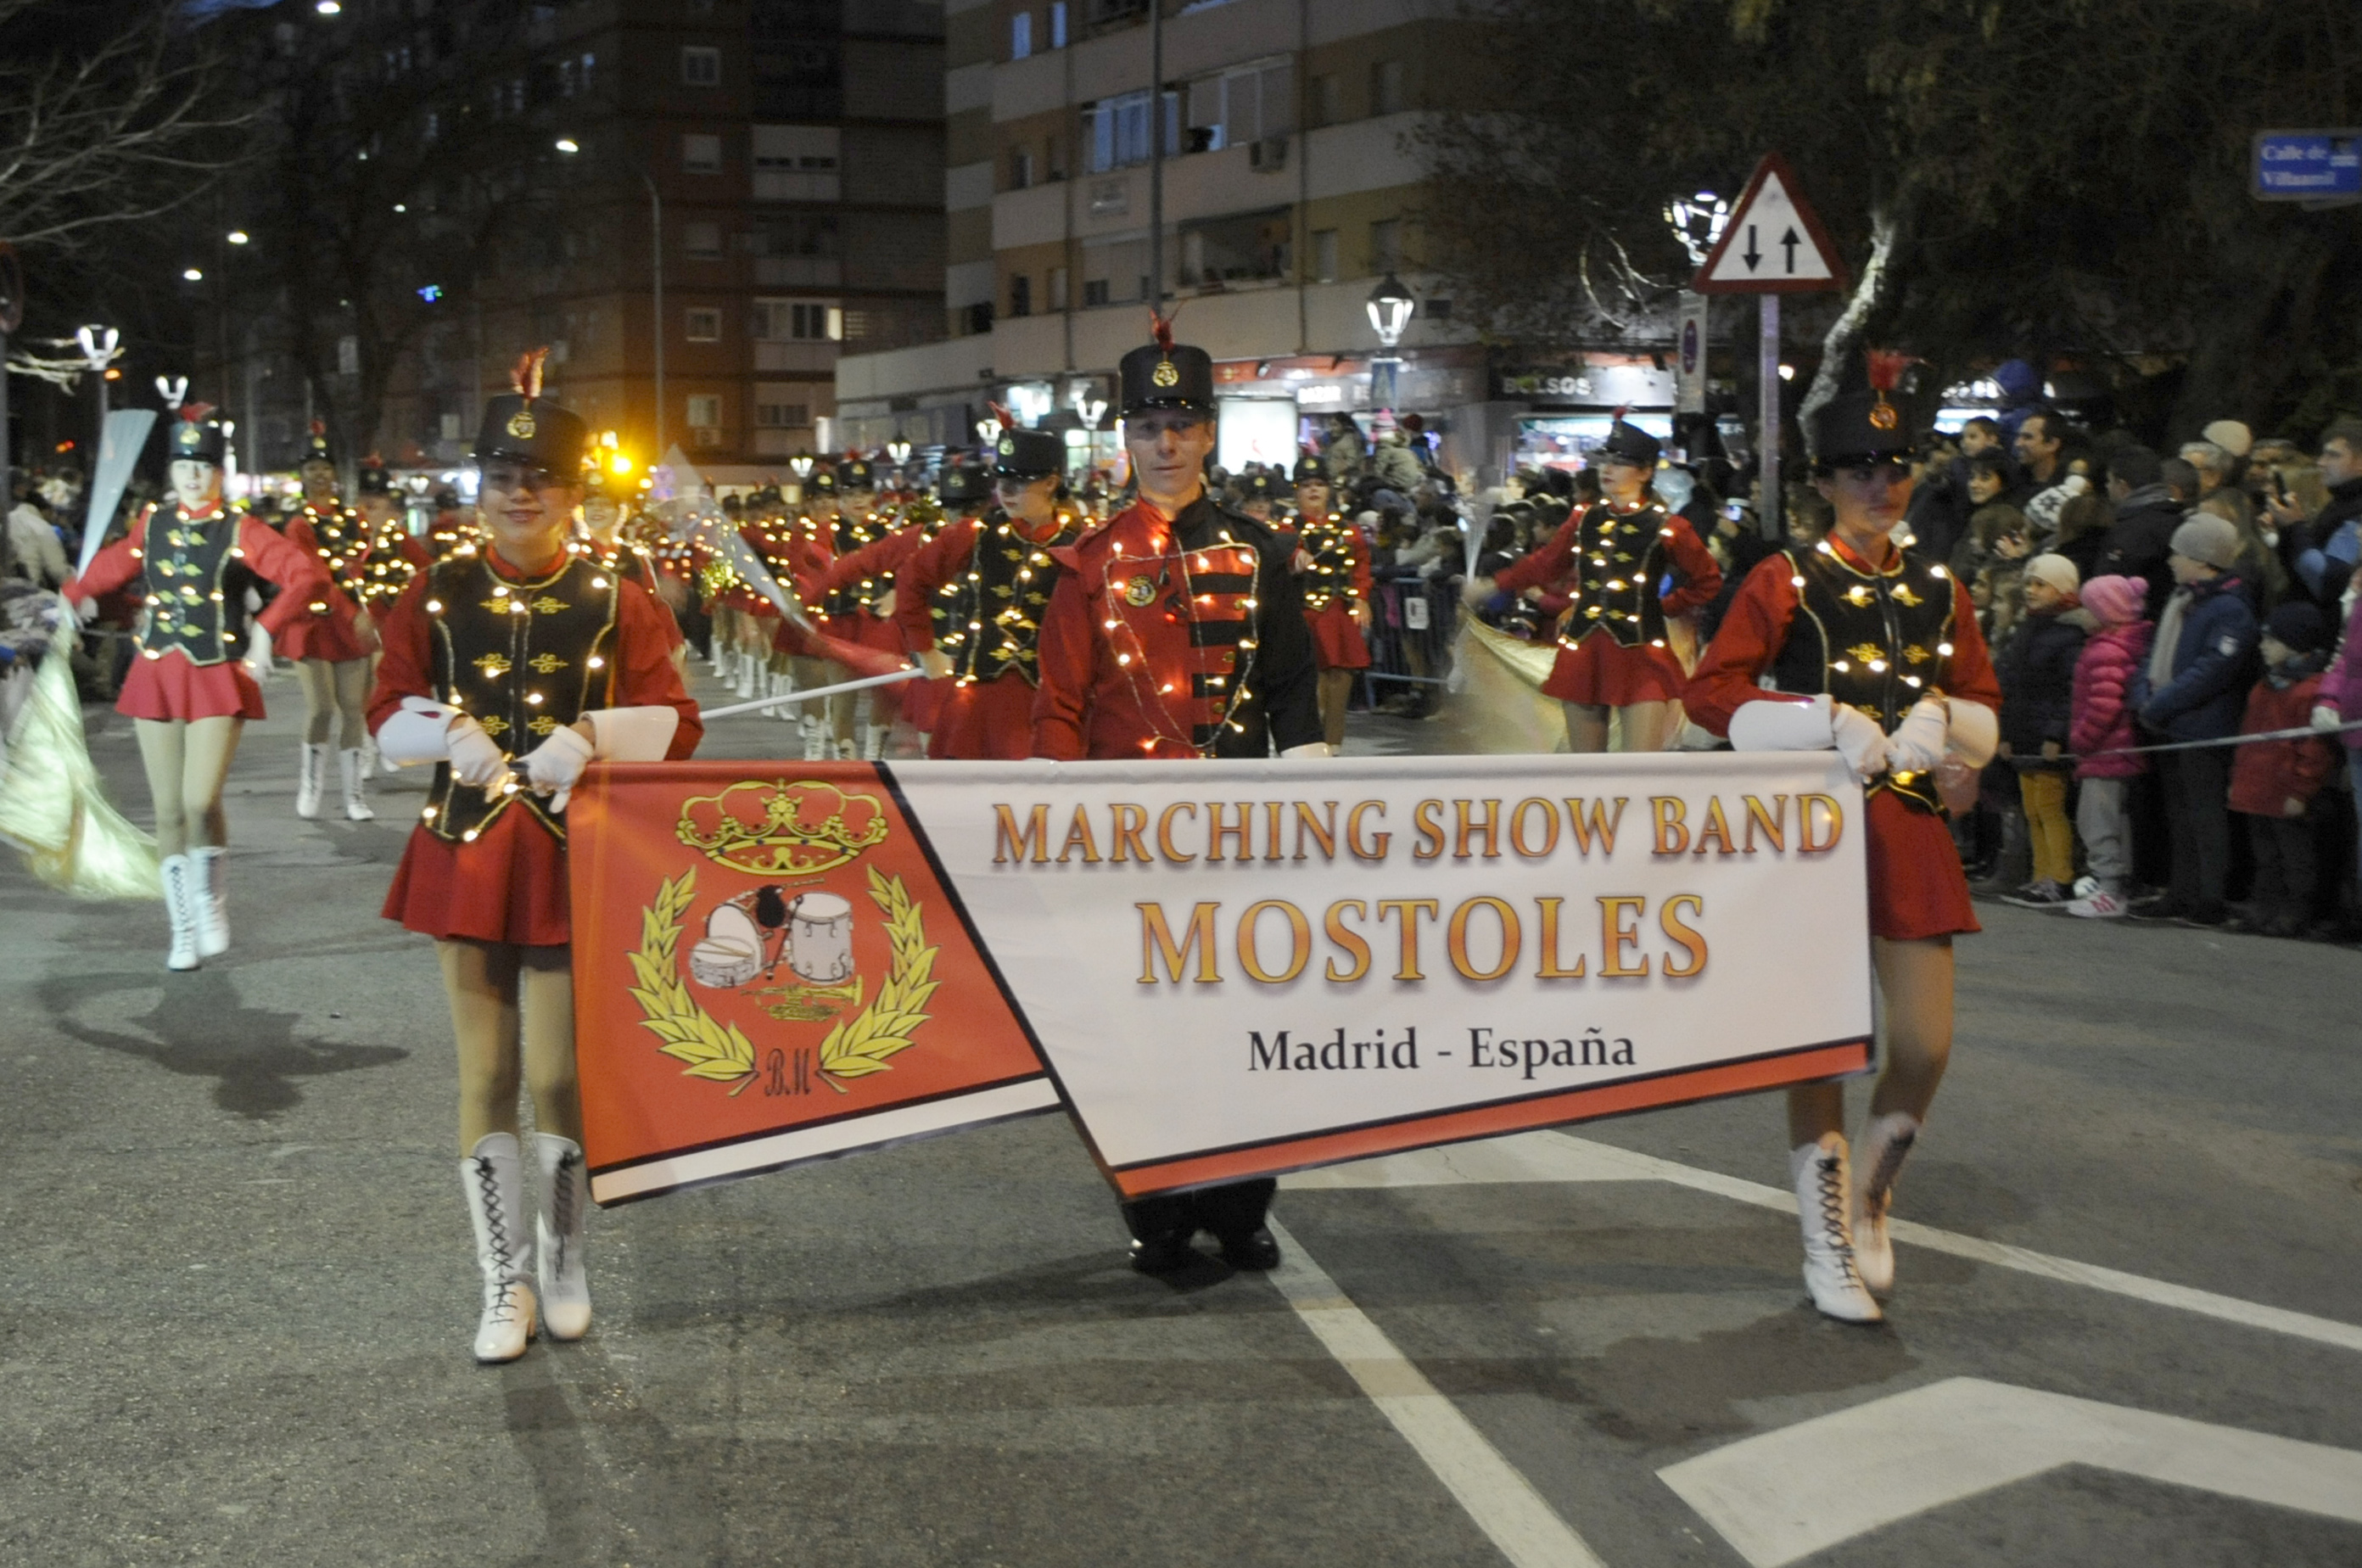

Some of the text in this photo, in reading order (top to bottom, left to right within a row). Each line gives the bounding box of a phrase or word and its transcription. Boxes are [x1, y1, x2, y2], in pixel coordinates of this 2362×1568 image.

[992, 793, 1844, 863] MARCHING SHOW BAND
[1136, 894, 1710, 984] MOSTOLES
[1248, 1027, 1420, 1071] Madrid
[1468, 1026, 1637, 1078] España
